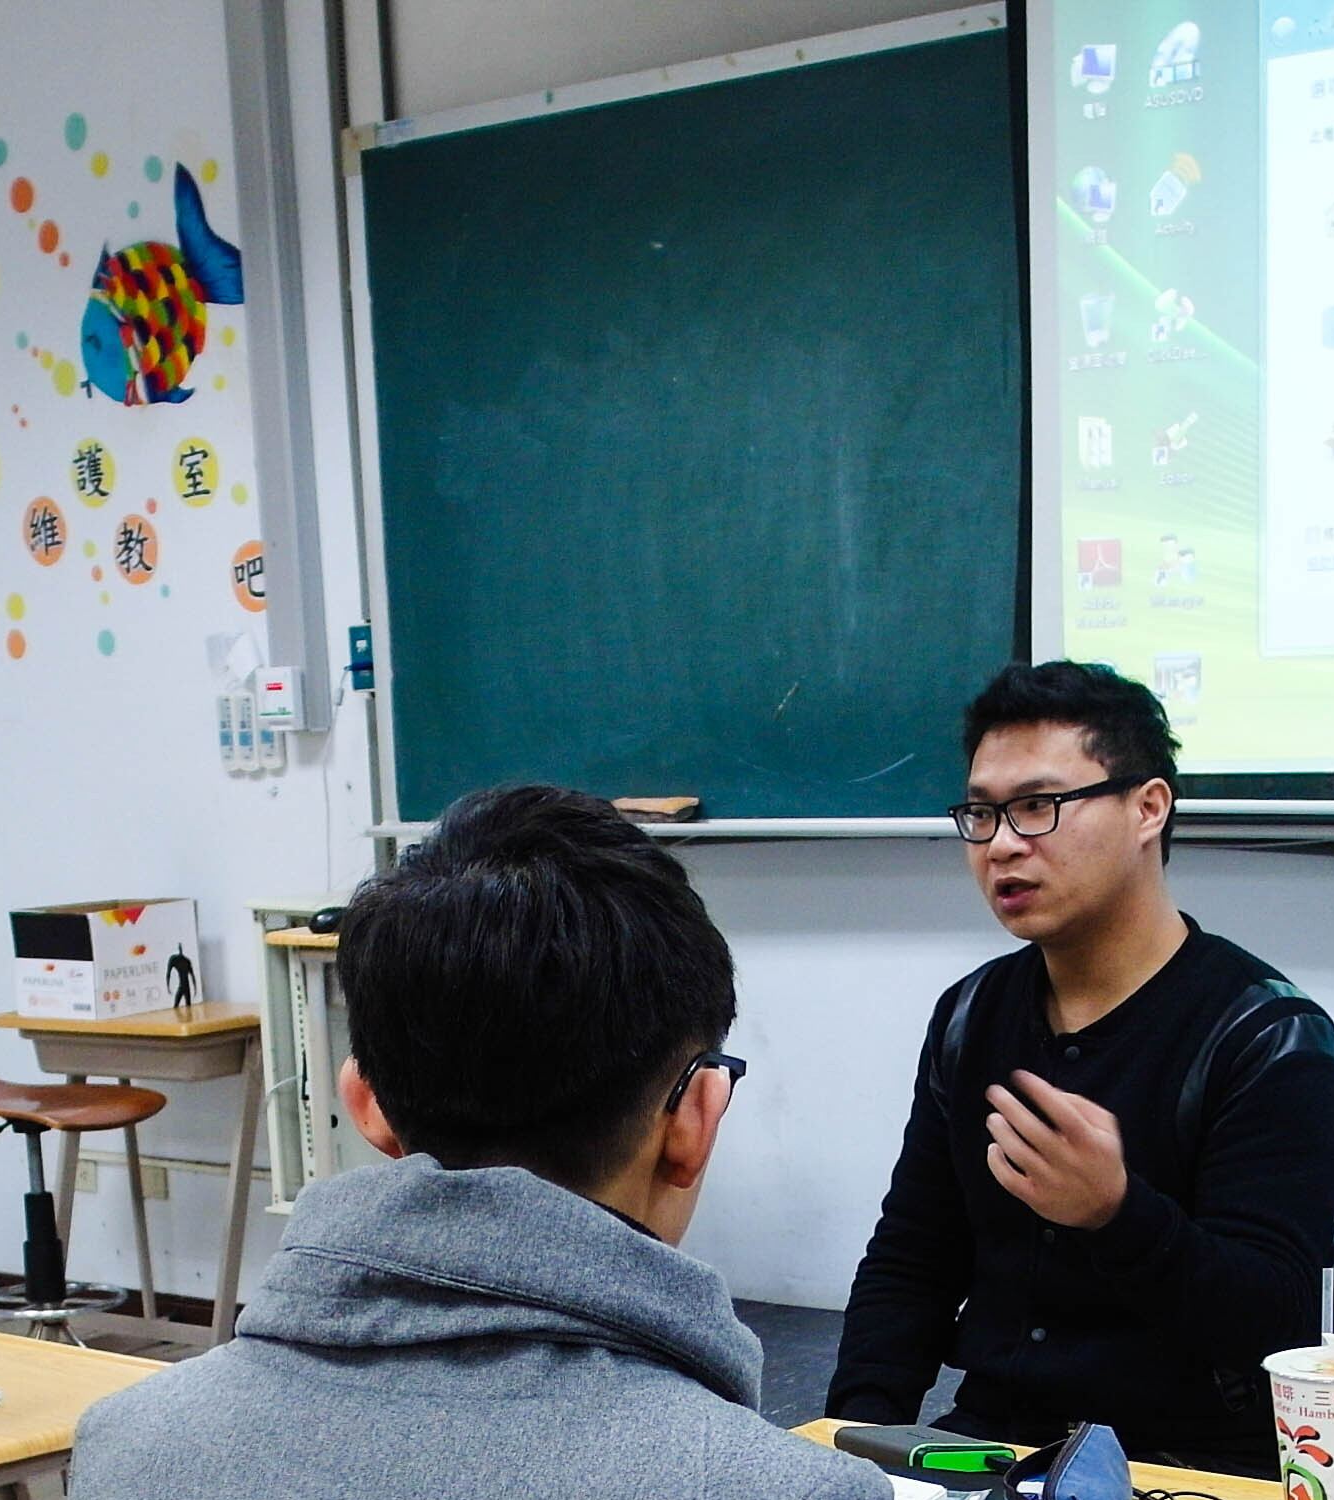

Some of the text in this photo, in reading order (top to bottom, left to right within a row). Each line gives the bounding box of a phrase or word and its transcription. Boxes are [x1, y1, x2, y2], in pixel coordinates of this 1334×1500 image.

[28, 447, 110, 554] 維 護
[114, 444, 267, 599] 教 室 吧
[102, 960, 161, 982] PAPERLINE
